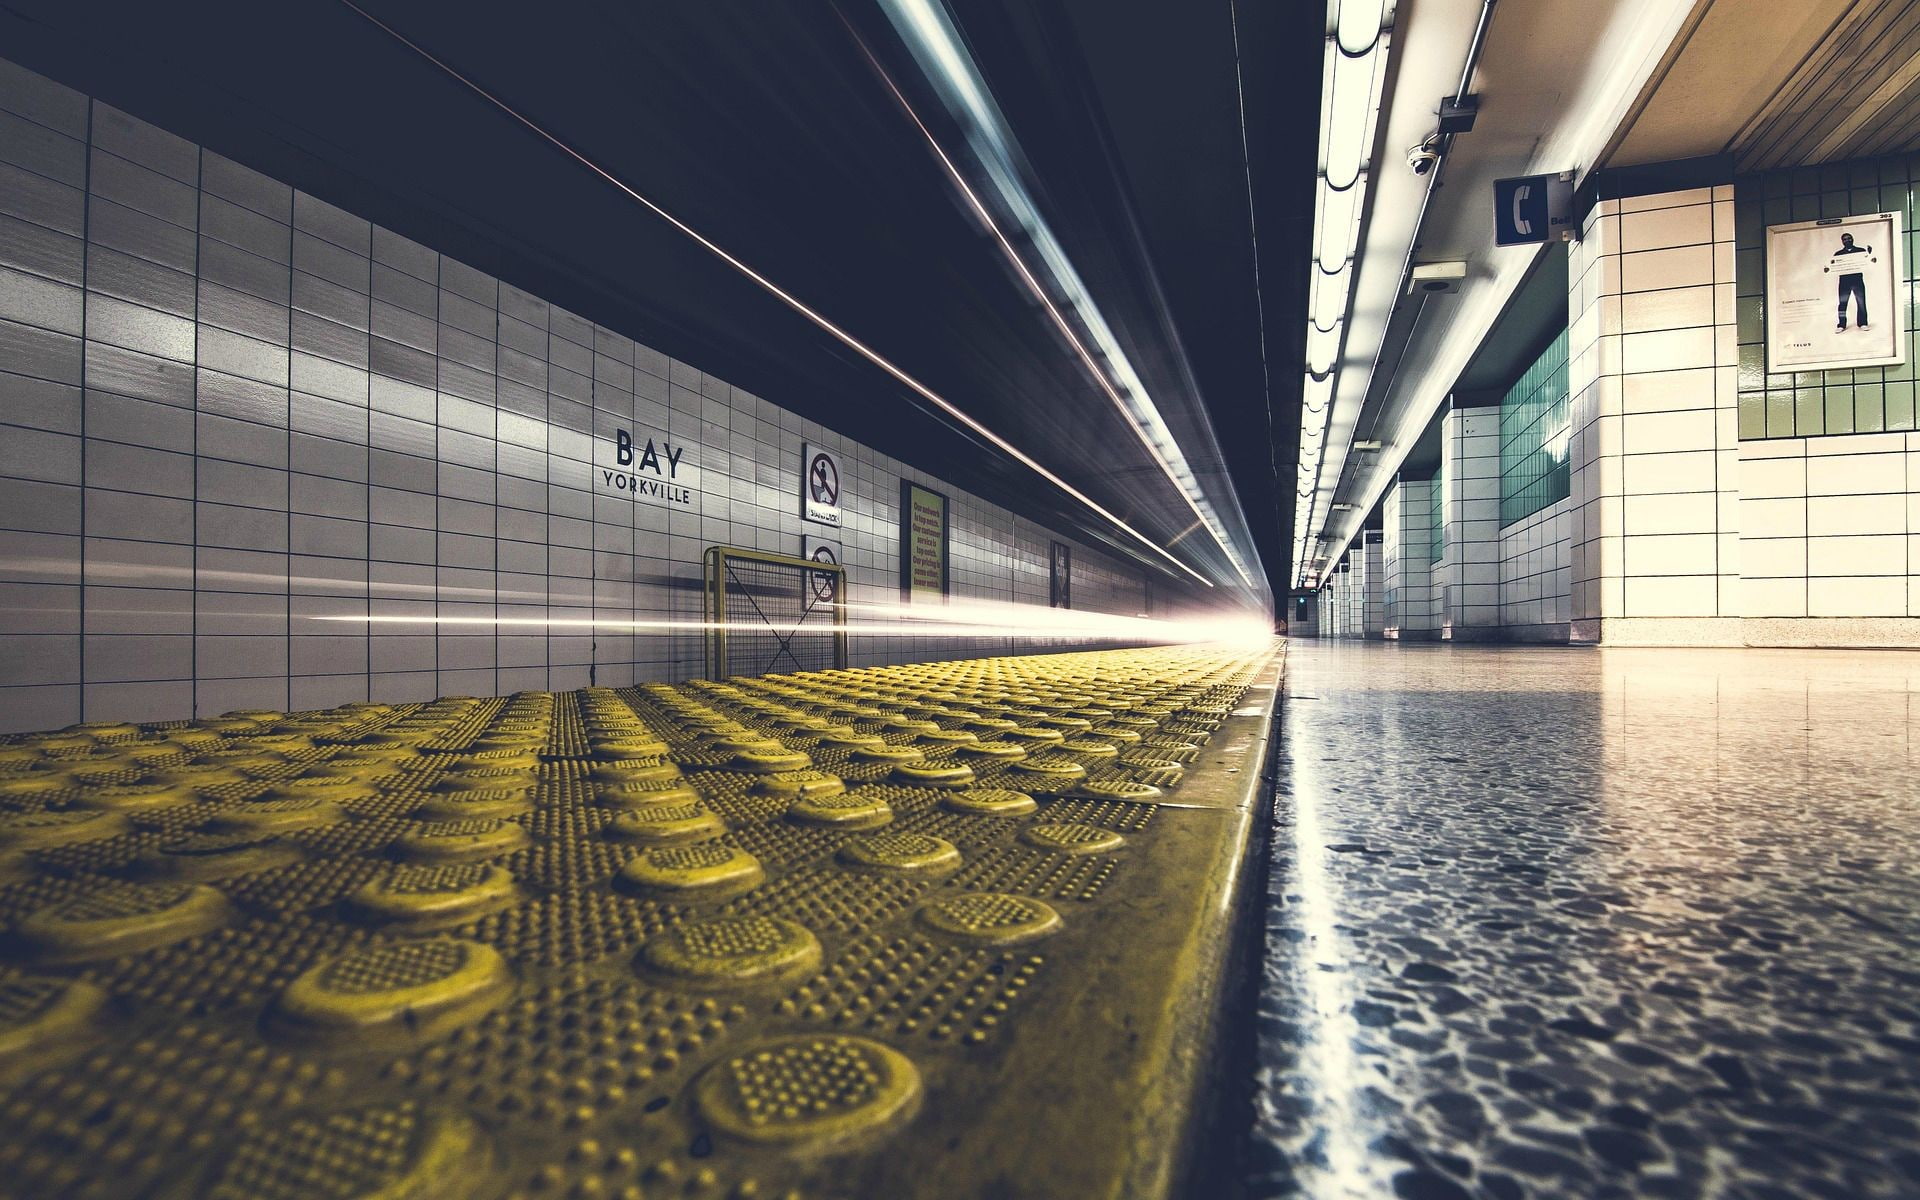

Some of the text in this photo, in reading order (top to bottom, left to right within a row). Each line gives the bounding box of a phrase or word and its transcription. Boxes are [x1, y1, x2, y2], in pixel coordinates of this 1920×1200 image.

[616, 428, 683, 479] BAY
[603, 470, 690, 505] YORKVILLE
[913, 502, 940, 518] Our network
[912, 523, 921, 533] Our
[916, 536, 932, 546] service
[916, 545, 924, 556] top
[912, 556, 921, 565] Our
[921, 557, 937, 569] pricing
[914, 568, 926, 576] some
